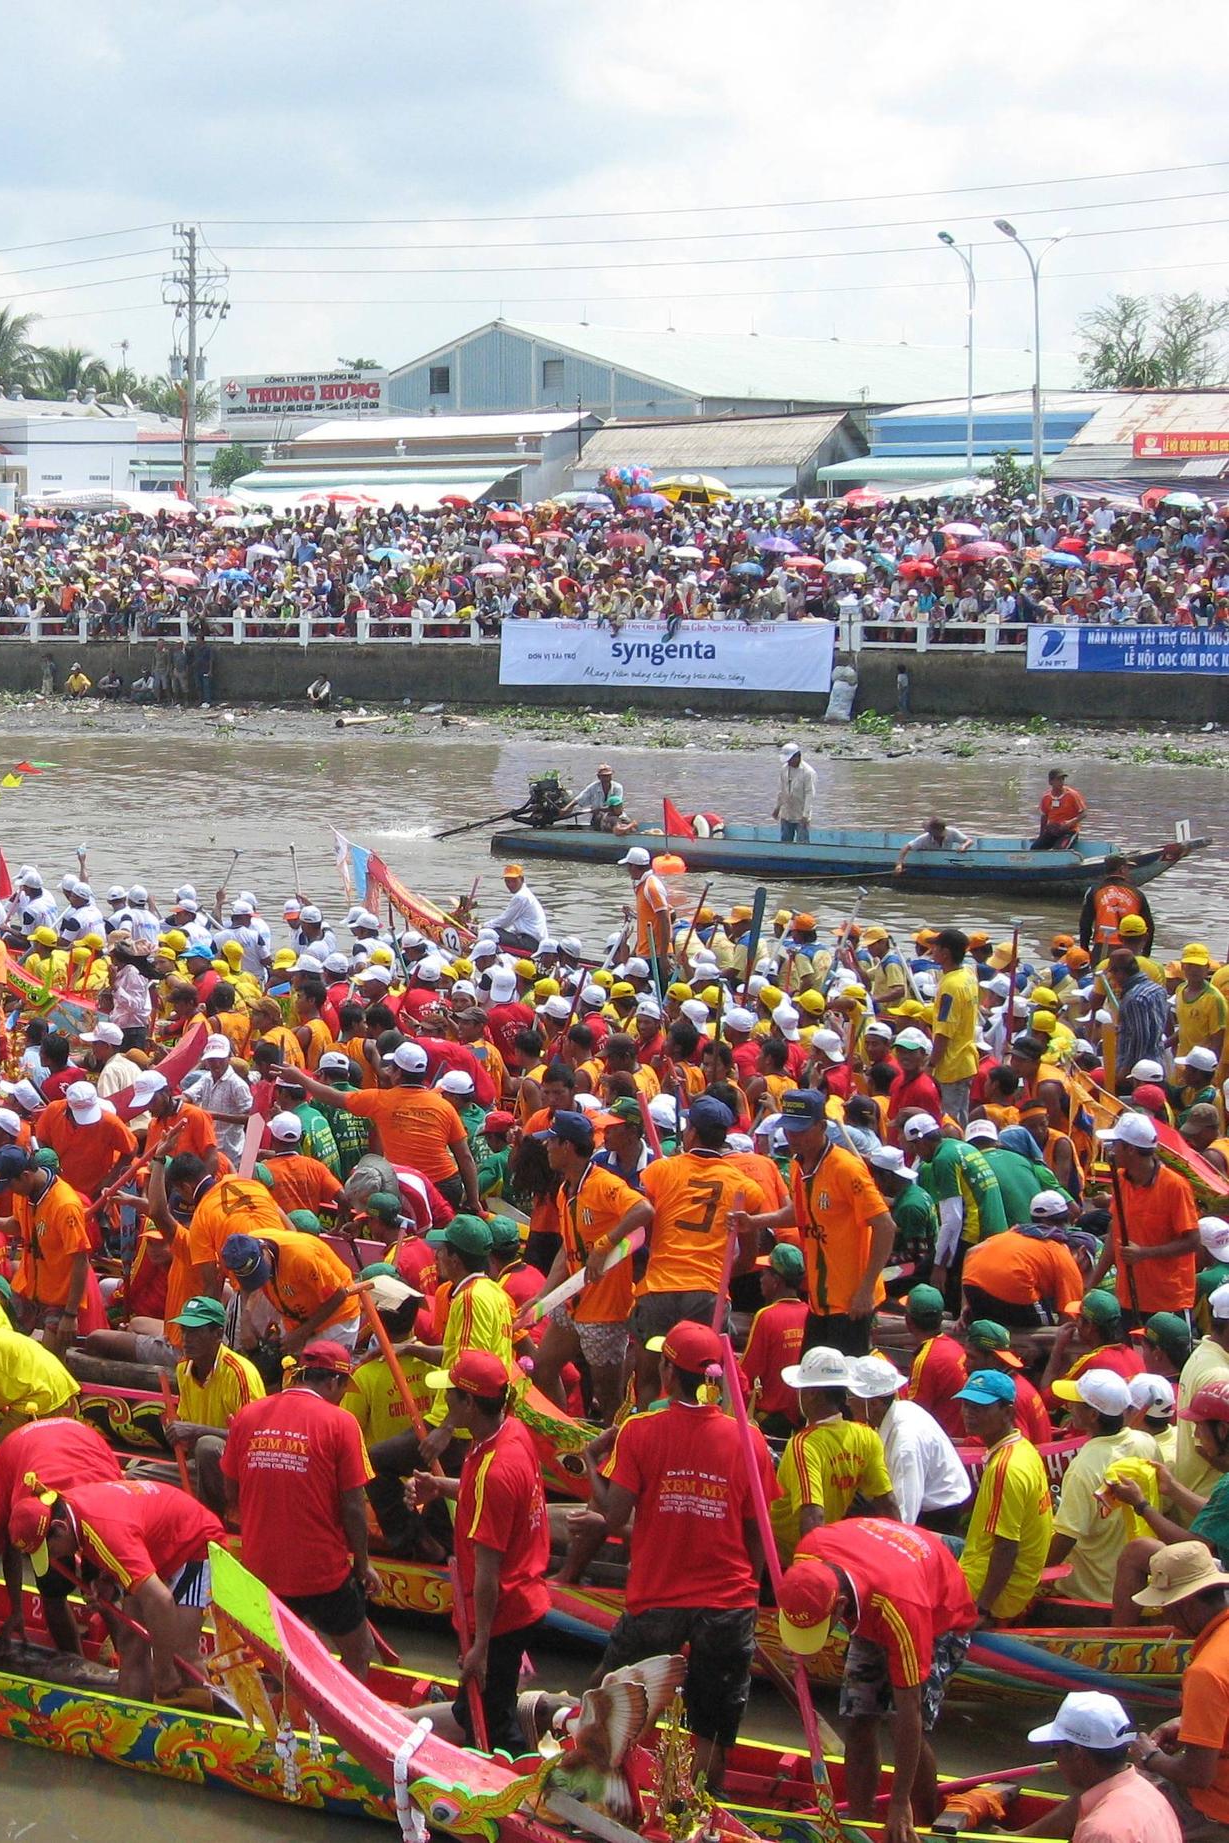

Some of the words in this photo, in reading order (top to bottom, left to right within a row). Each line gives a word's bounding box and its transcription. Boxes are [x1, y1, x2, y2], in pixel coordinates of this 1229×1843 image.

[611, 638, 716, 666] syngenta
[1137, 649, 1155, 670] HỘI
[445, 932, 459, 952] 12
[675, 1178, 723, 1233] 3
[248, 1437, 282, 1450] XEM
[659, 1480, 697, 1494] XEM
